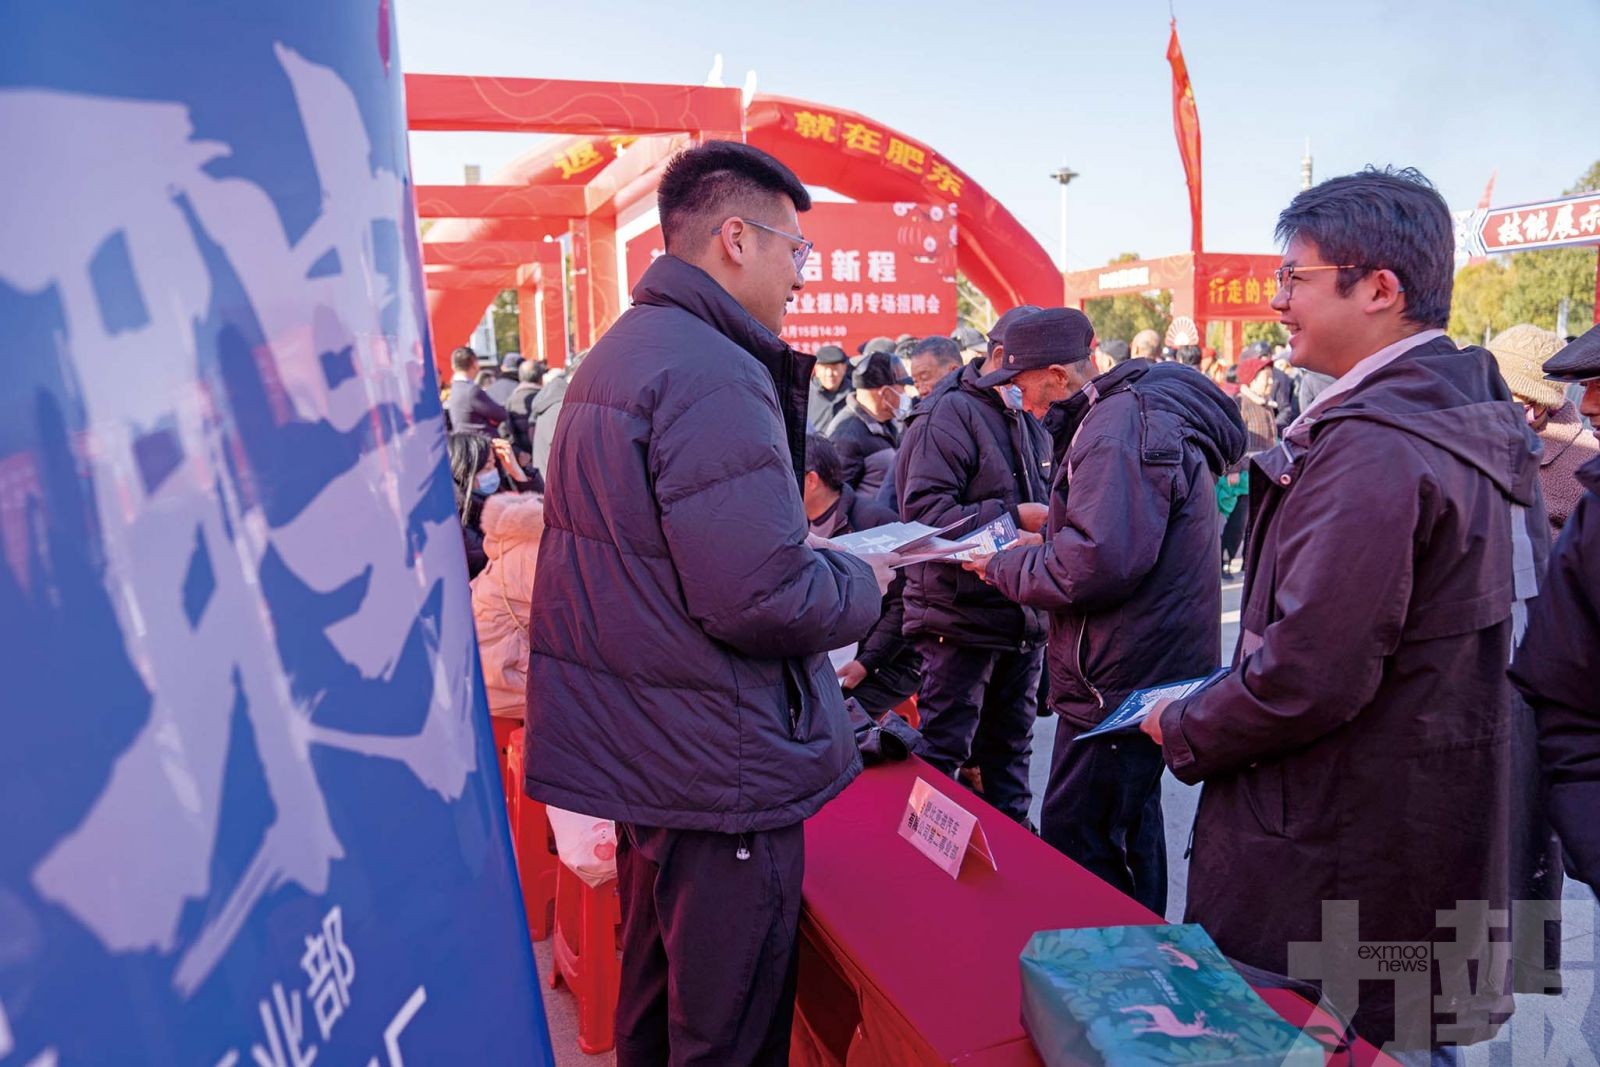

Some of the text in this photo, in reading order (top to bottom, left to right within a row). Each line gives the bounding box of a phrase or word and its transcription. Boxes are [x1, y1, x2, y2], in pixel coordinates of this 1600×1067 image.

[794, 111, 964, 197] 就在肥东
[1497, 203, 1600, 246] 技能展示
[228, 906, 355, 1067] 业部
